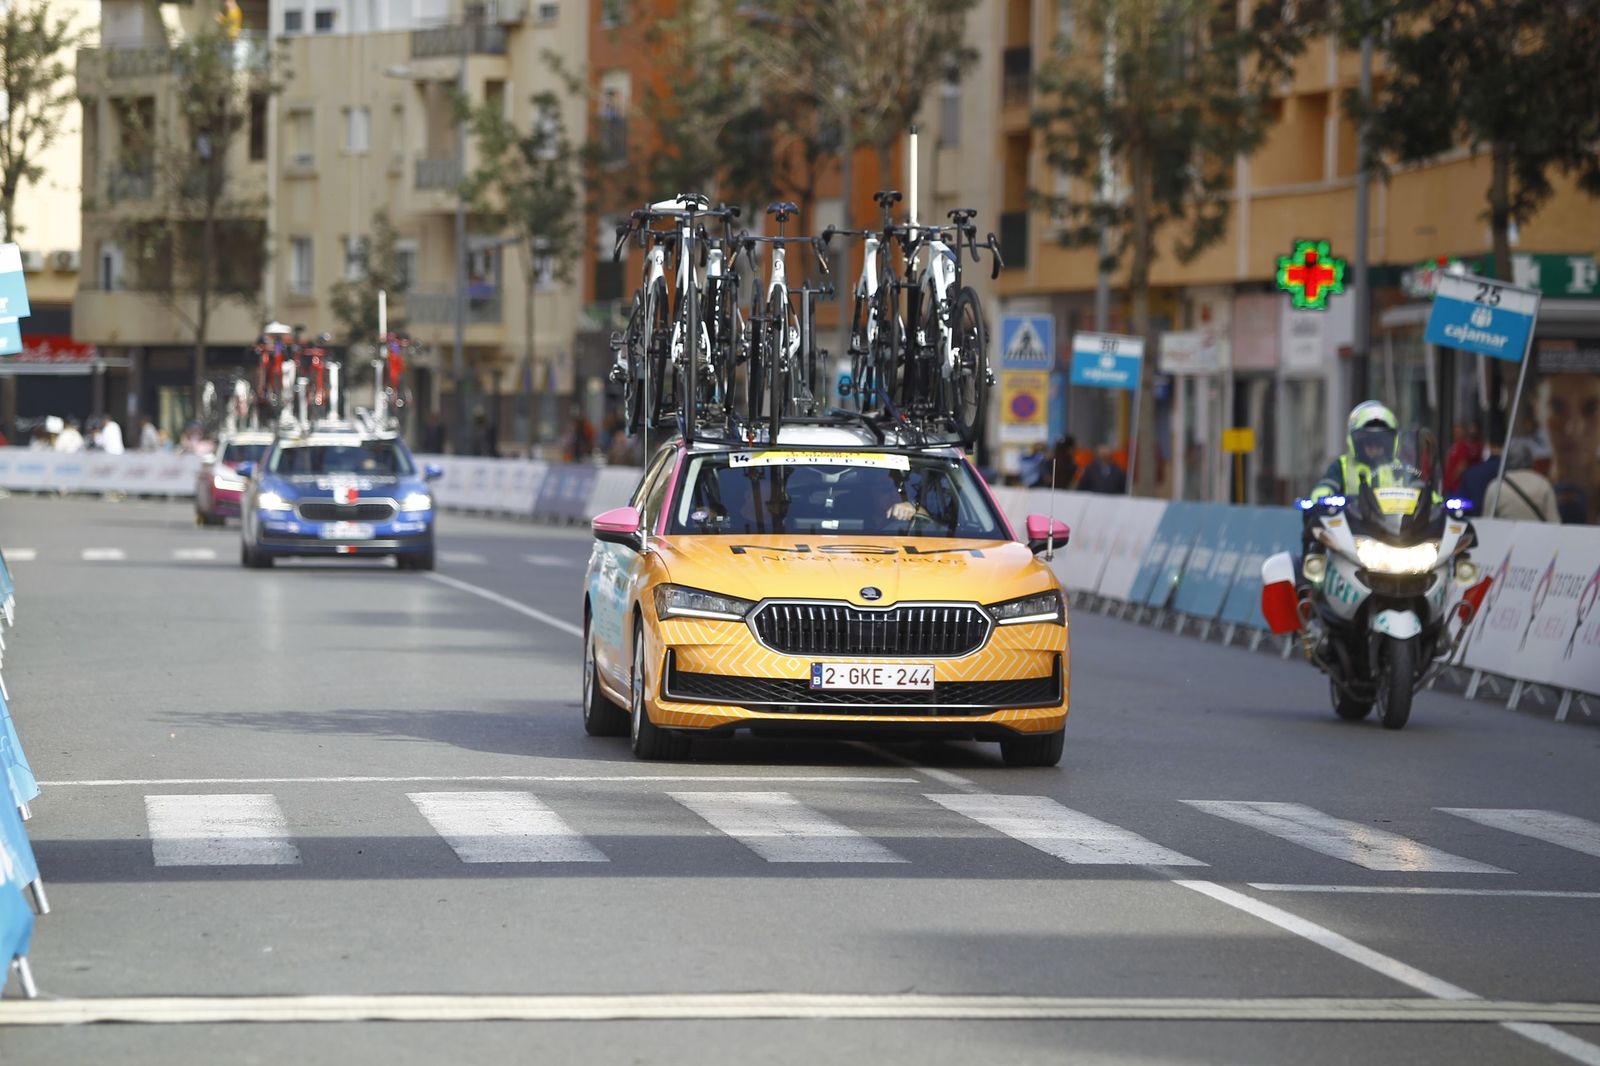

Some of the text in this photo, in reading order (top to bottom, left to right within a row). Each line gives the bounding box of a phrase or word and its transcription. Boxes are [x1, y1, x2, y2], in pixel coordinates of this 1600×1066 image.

[1474, 282, 1504, 306] 25
[1444, 323, 1509, 348] cajamar
[733, 454, 750, 463] 14
[813, 676, 821, 685] B
[825, 667, 930, 685] 2-GKE-244
